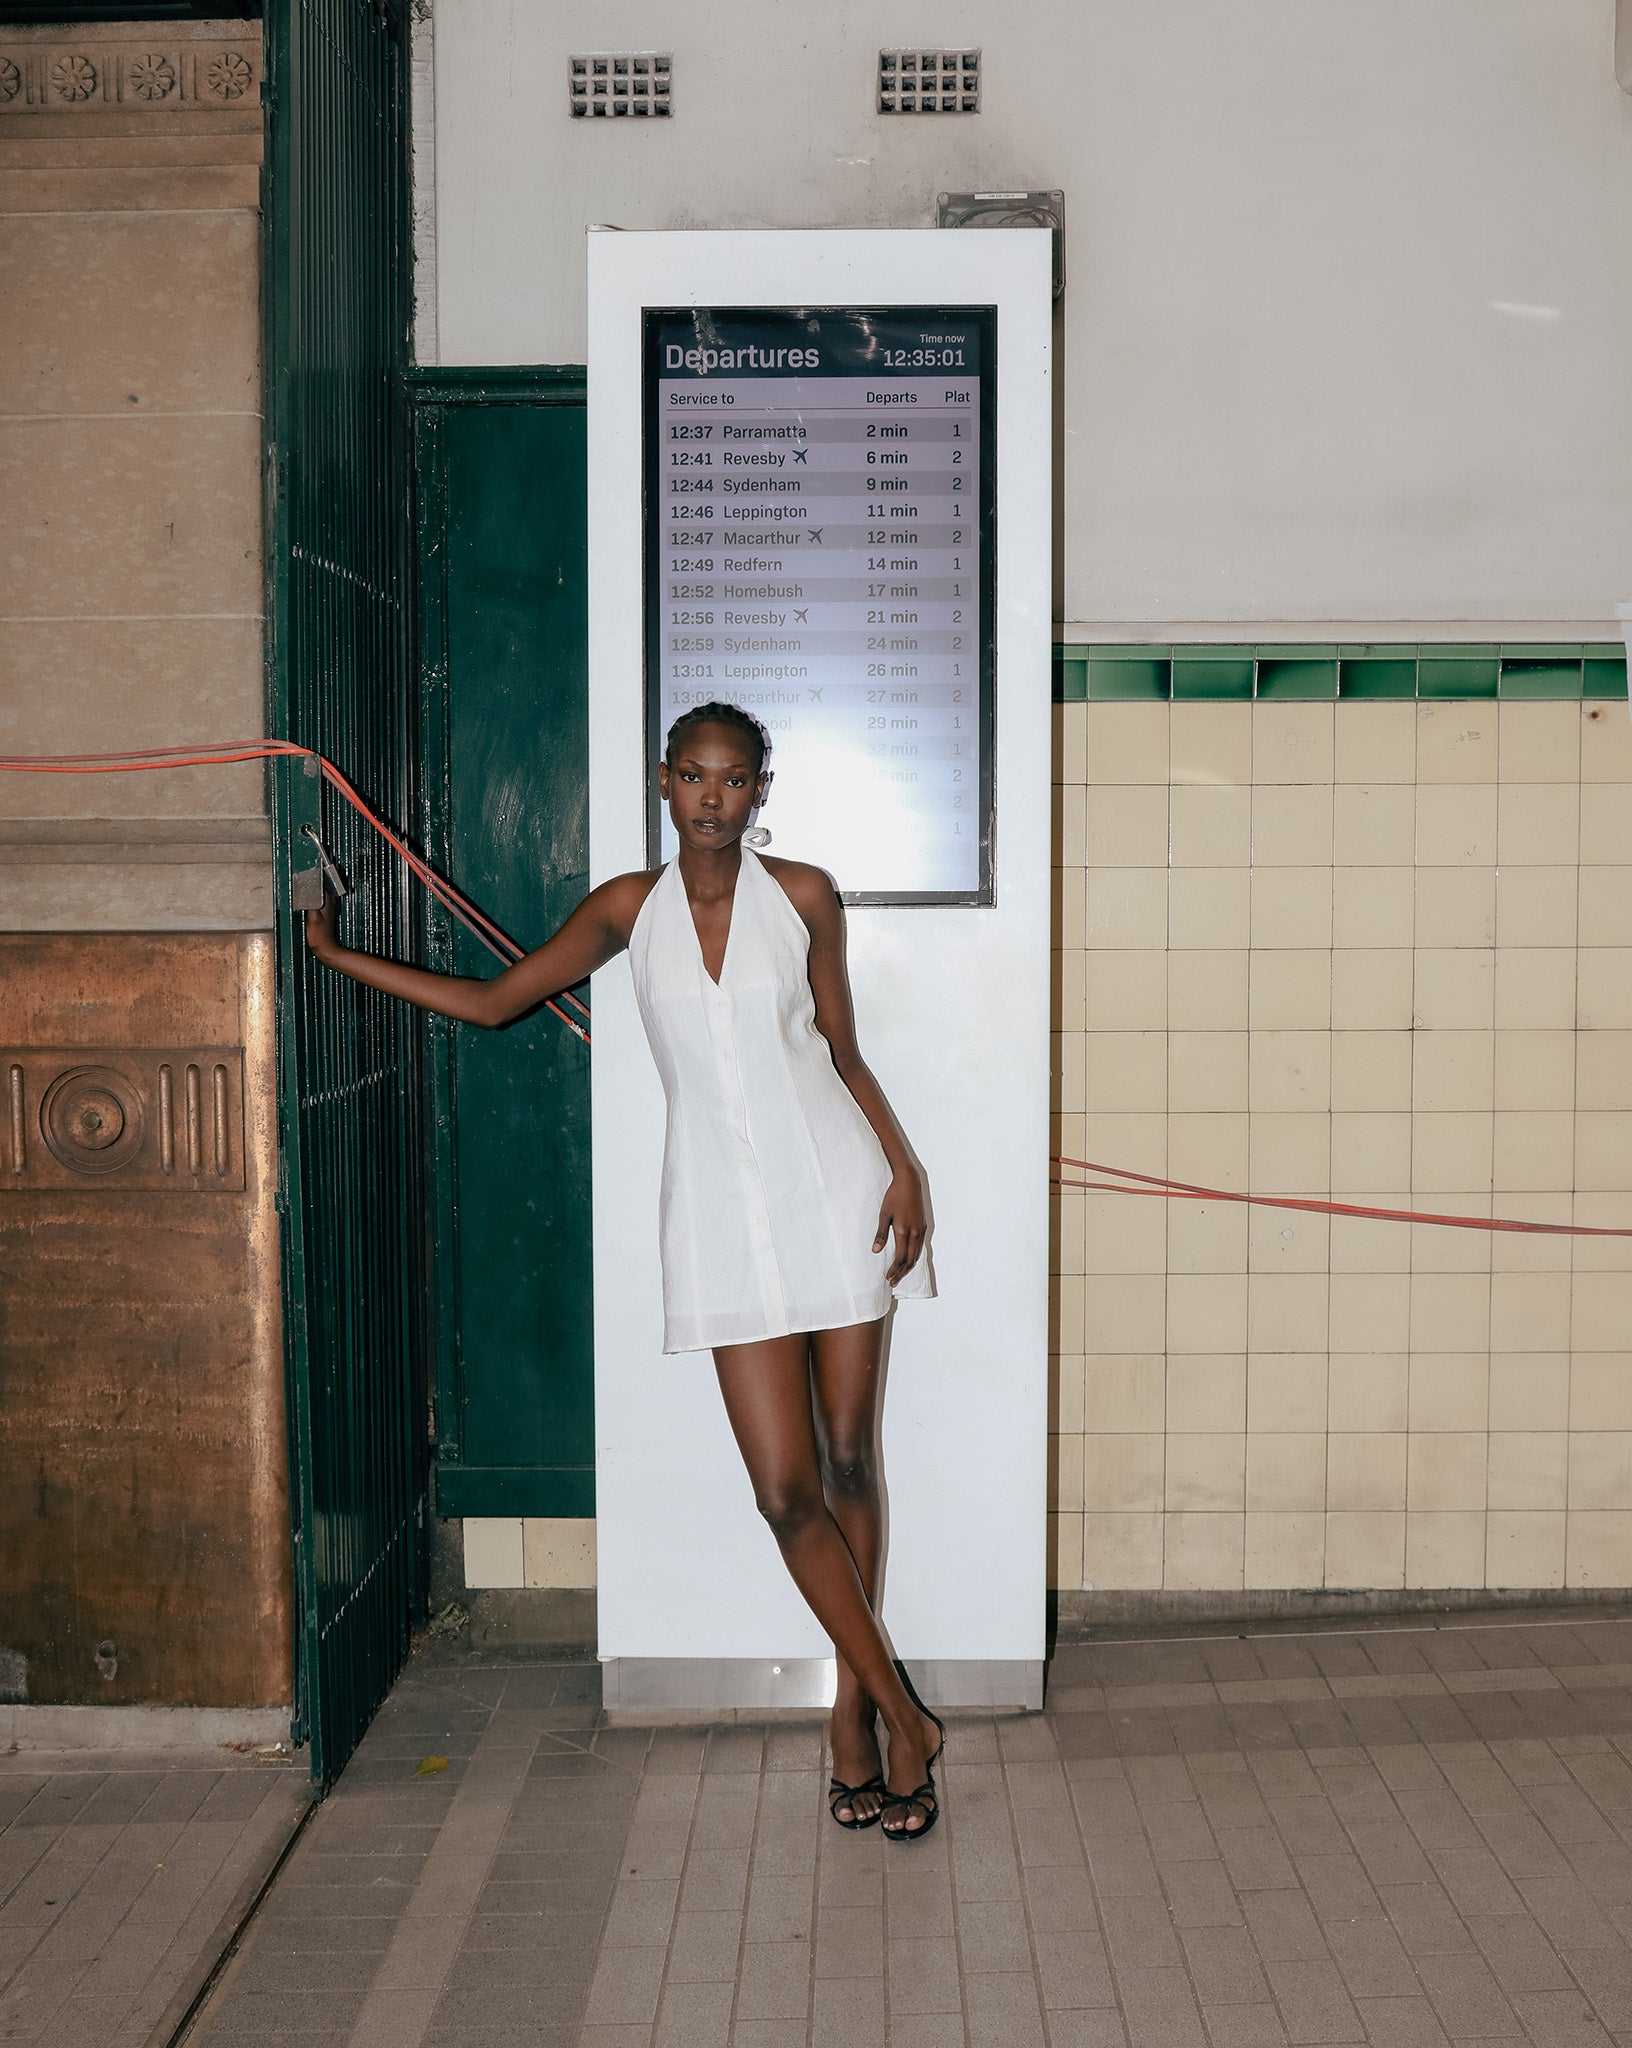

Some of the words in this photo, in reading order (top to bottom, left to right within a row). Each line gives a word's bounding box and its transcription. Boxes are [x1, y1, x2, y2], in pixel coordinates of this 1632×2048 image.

[920, 334, 942, 343] Time
[666, 344, 819, 371] Departures
[884, 349, 965, 367] 12:35:01
[671, 393, 717, 404] Service
[721, 394, 734, 404] to
[866, 391, 917, 405] Departs
[946, 391, 970, 402] Plat
[671, 426, 713, 438] 12:37
[724, 426, 806, 438] Parramatta
[867, 425, 875, 437] 2
[881, 424, 907, 437] min
[954, 424, 961, 436] 1
[672, 453, 712, 465] 12:41
[724, 452, 785, 467] Revesby
[867, 451, 875, 464] 6
[881, 451, 907, 463] min
[953, 451, 961, 463] 2
[672, 479, 713, 492] 12:44
[724, 478, 800, 494] Sydenham
[867, 478, 875, 490] 9
[881, 477, 907, 490] min
[953, 478, 961, 490] 2
[672, 506, 713, 518] 12:46
[724, 505, 806, 521] Leppington
[868, 505, 885, 517] 11
[891, 504, 917, 516] min
[954, 504, 961, 516] 1
[672, 533, 713, 545] 12:47
[724, 531, 800, 544] Macarthur
[868, 531, 885, 543] 12
[891, 530, 917, 543] min
[953, 531, 961, 543] 2
[672, 559, 713, 571] 12:49
[725, 558, 781, 571] Redfern
[868, 558, 886, 570] 14
[891, 557, 917, 570] min
[954, 558, 961, 569] 1
[672, 586, 713, 598] 12:52
[725, 584, 802, 597] Homebush
[868, 584, 886, 596] 17
[891, 583, 917, 596] min
[954, 584, 961, 596] 1
[672, 612, 713, 624] 12:56
[725, 611, 786, 626] Revesby
[868, 611, 885, 623] 21
[891, 610, 917, 623] min
[953, 610, 961, 623] 2
[672, 639, 714, 651] 12:59
[724, 638, 800, 653] Sydenham
[867, 637, 886, 649] 24
[891, 636, 918, 649] min
[953, 637, 962, 649] 2
[673, 665, 713, 677] 13:01
[725, 664, 807, 680] Leppington
[868, 664, 886, 676] 26
[891, 663, 918, 676] min
[954, 663, 961, 676] 1
[673, 692, 714, 704] 13:02
[725, 691, 801, 704] Macarthur
[867, 690, 886, 702] 27
[891, 690, 917, 702] min
[953, 690, 962, 702] 2
[867, 716, 886, 729] 29
[891, 716, 918, 729] min
[953, 717, 962, 728] 1
[891, 743, 918, 755] min
[953, 743, 962, 755] 1
[953, 770, 962, 781] 2
[953, 796, 962, 807] 2
[953, 822, 962, 834] 1
